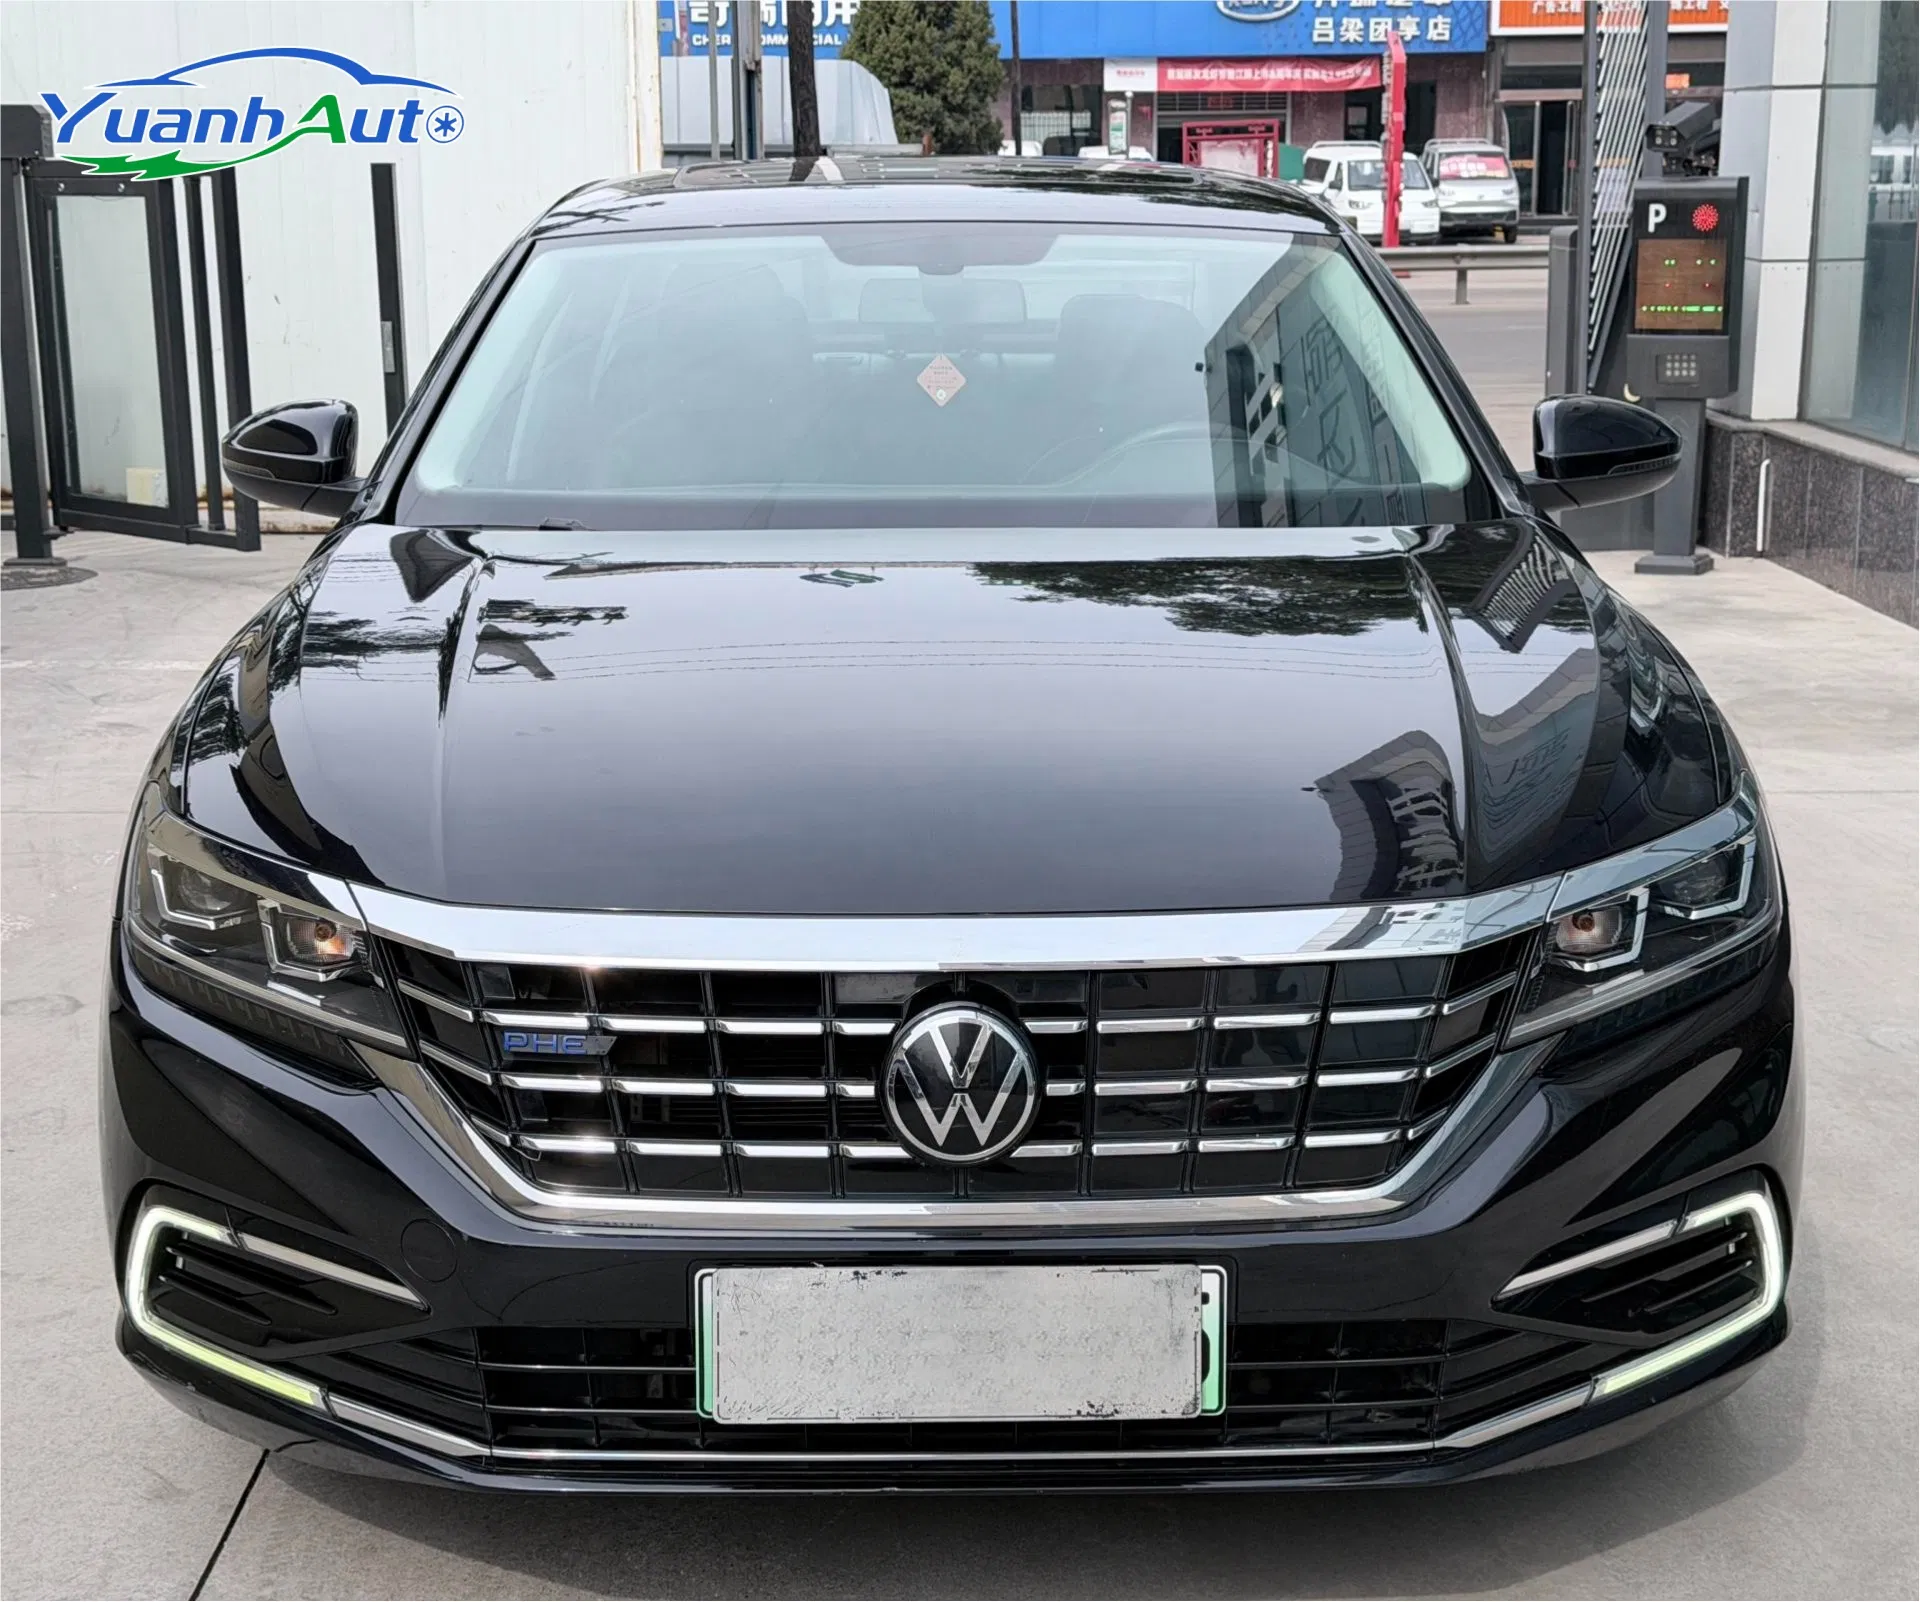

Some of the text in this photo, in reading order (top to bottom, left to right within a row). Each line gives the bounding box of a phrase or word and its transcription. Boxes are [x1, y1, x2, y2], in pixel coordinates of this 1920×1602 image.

[692, 34, 732, 46] CHER
[1313, 15, 1451, 43] 吕梁团享店
[1647, 203, 1667, 233] P
